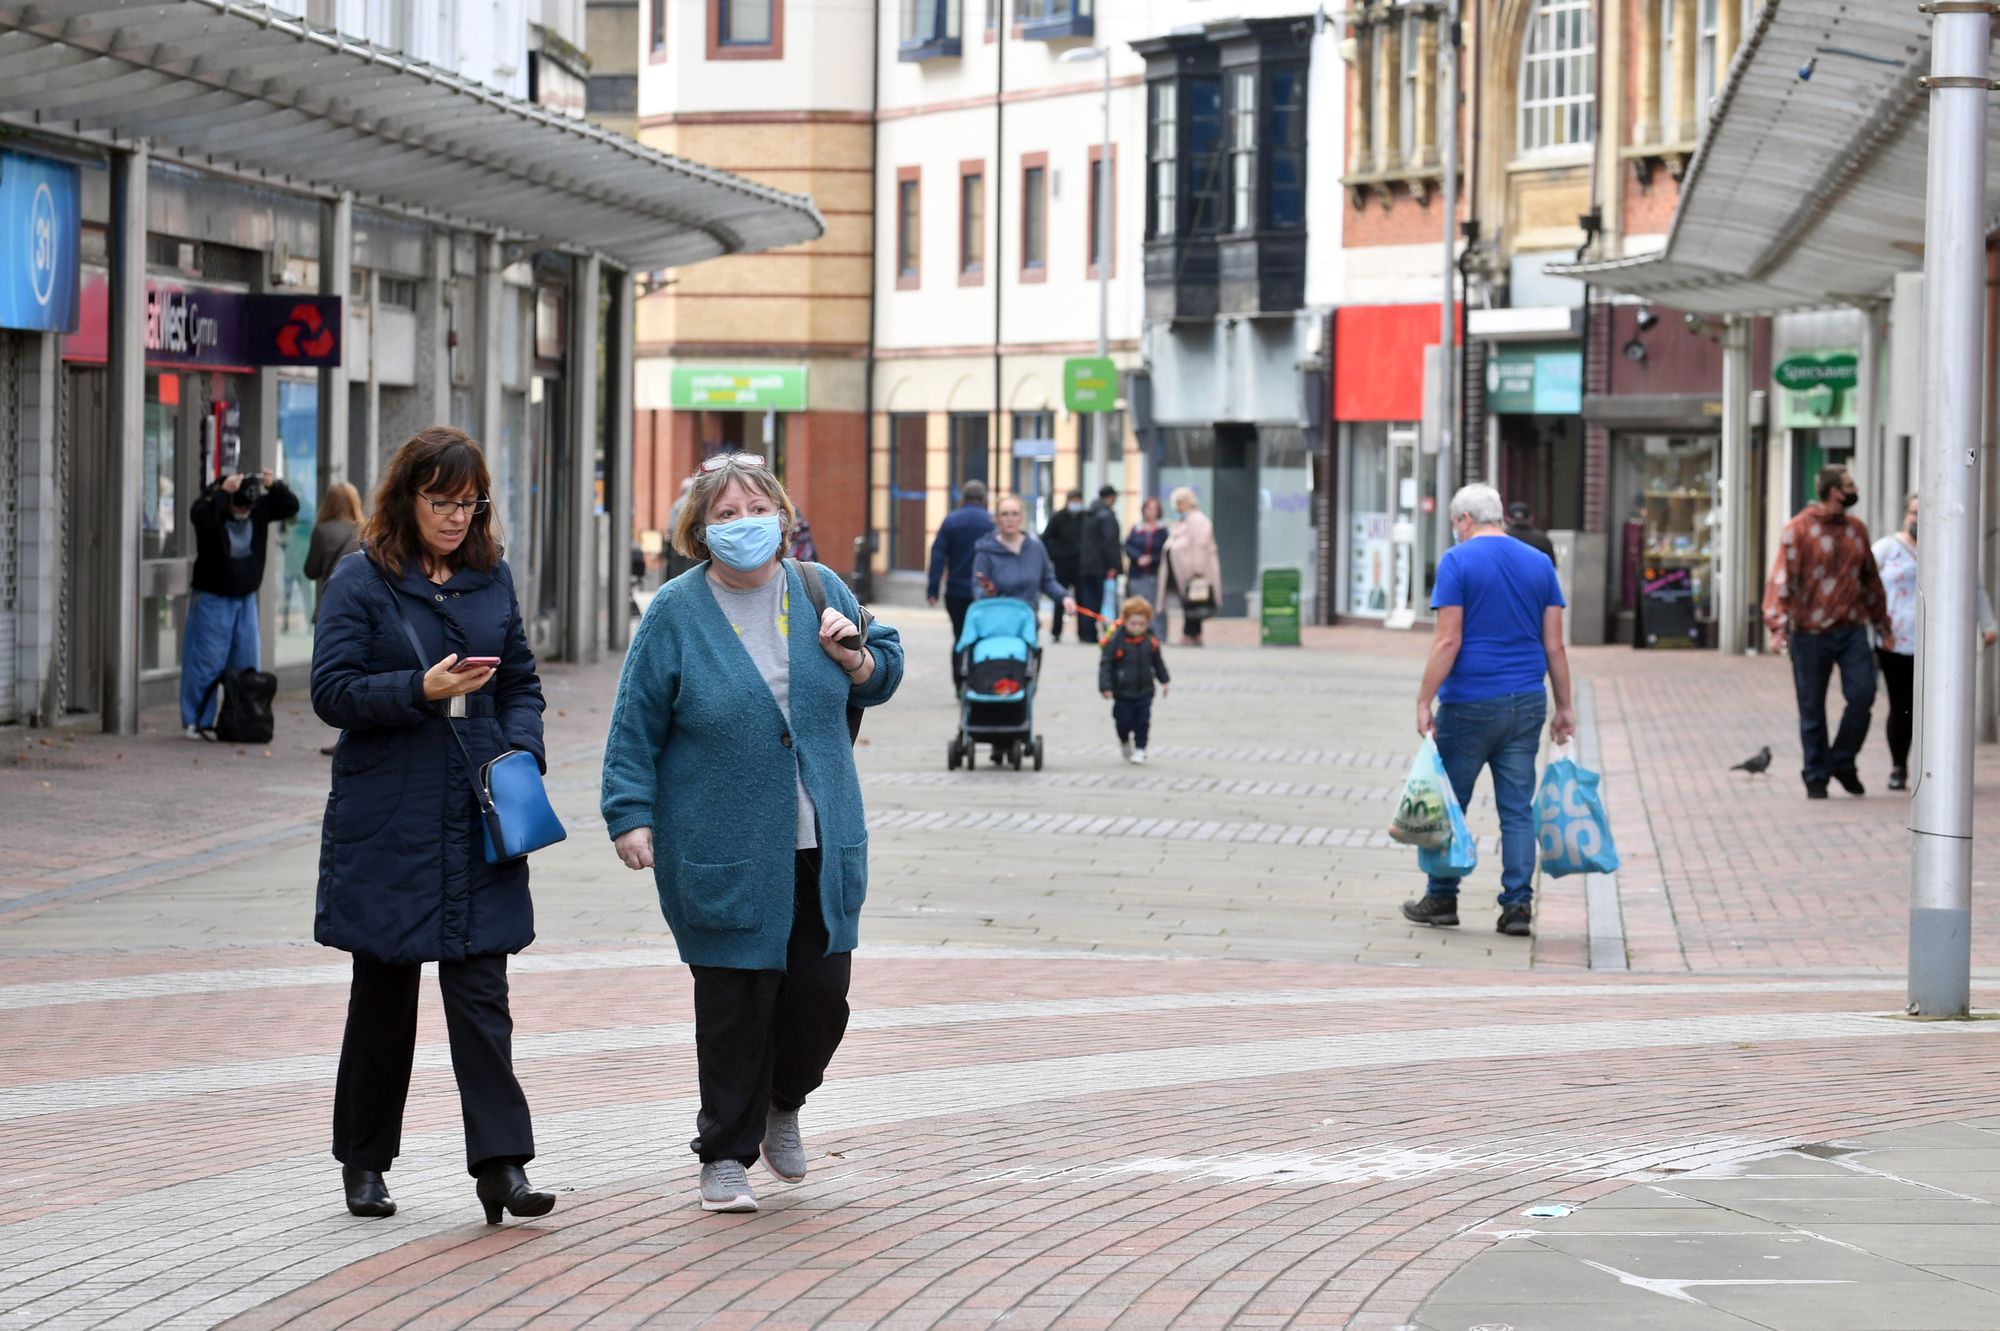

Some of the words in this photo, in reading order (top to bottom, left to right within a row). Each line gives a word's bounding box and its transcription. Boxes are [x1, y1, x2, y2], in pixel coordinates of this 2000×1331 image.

[36, 217, 51, 272] 31
[145, 291, 188, 353] atWest
[189, 302, 218, 358] Cymru
